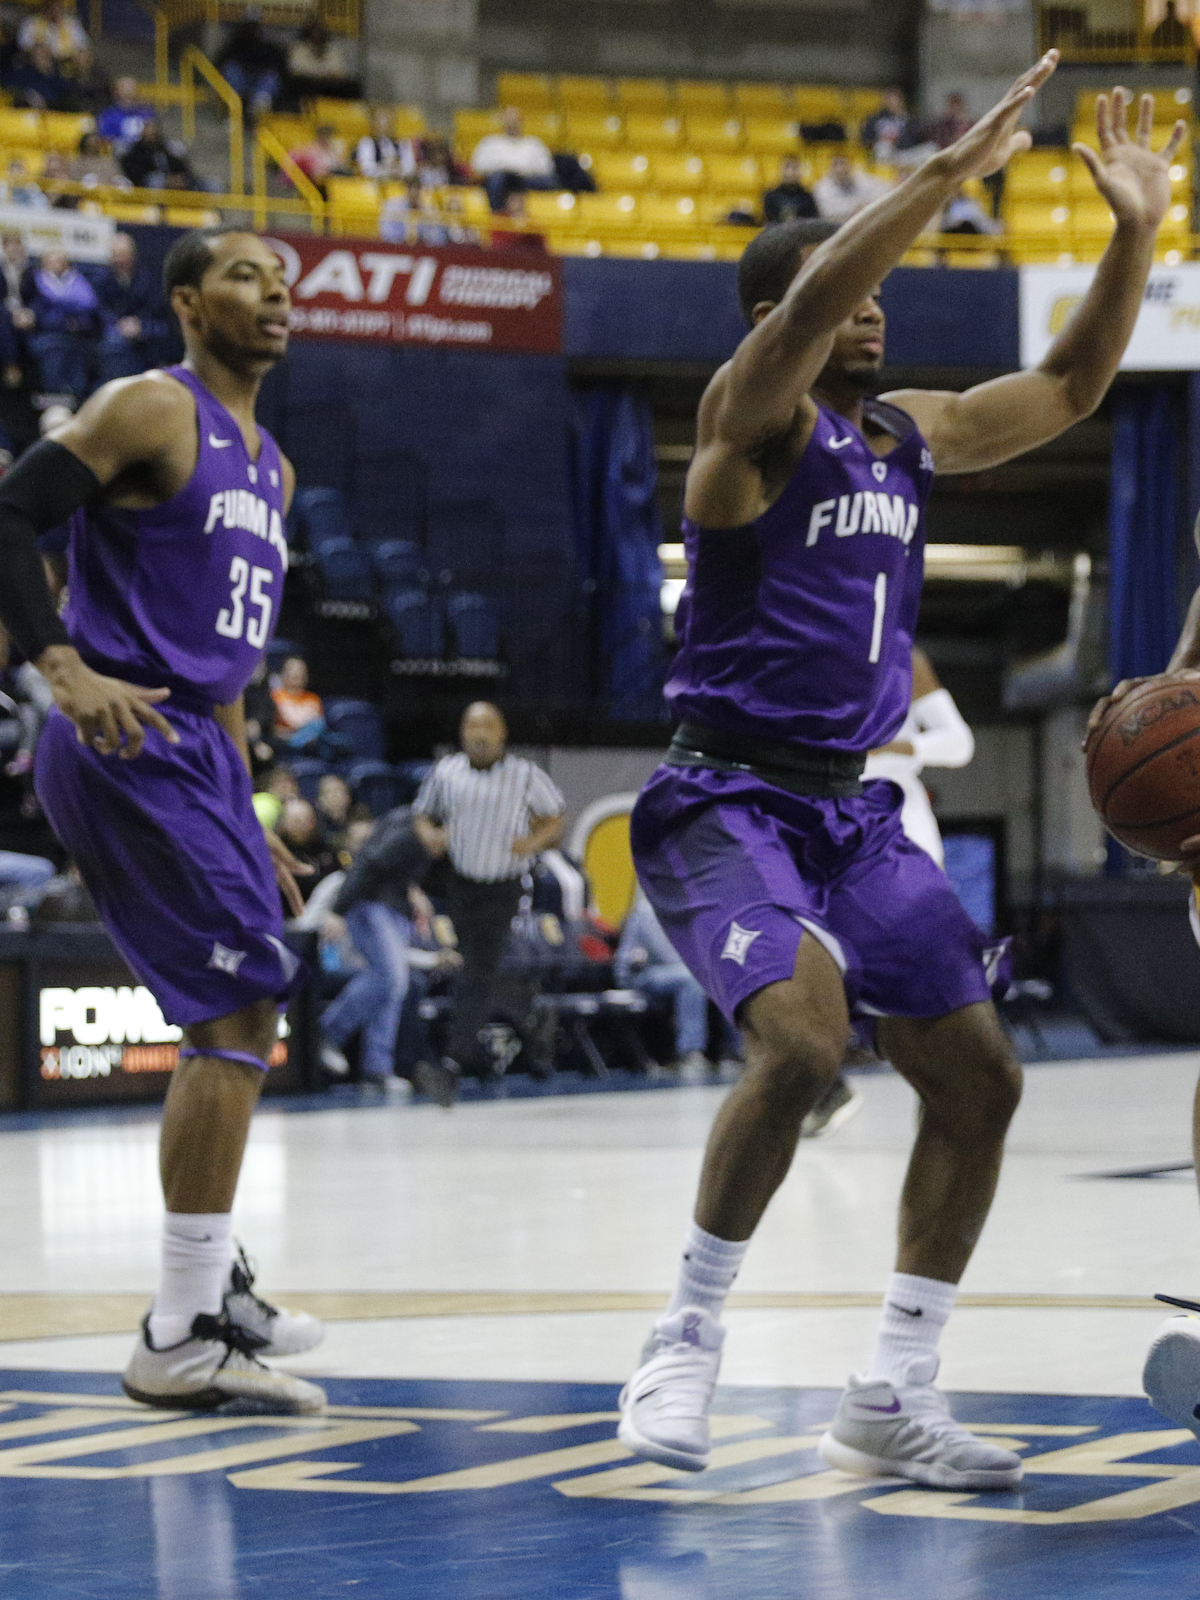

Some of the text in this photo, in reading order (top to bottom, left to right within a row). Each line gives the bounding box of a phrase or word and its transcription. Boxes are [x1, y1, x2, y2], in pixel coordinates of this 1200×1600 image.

[297, 250, 438, 306] ATI
[215, 555, 274, 650] 35
[868, 571, 888, 663] 1
